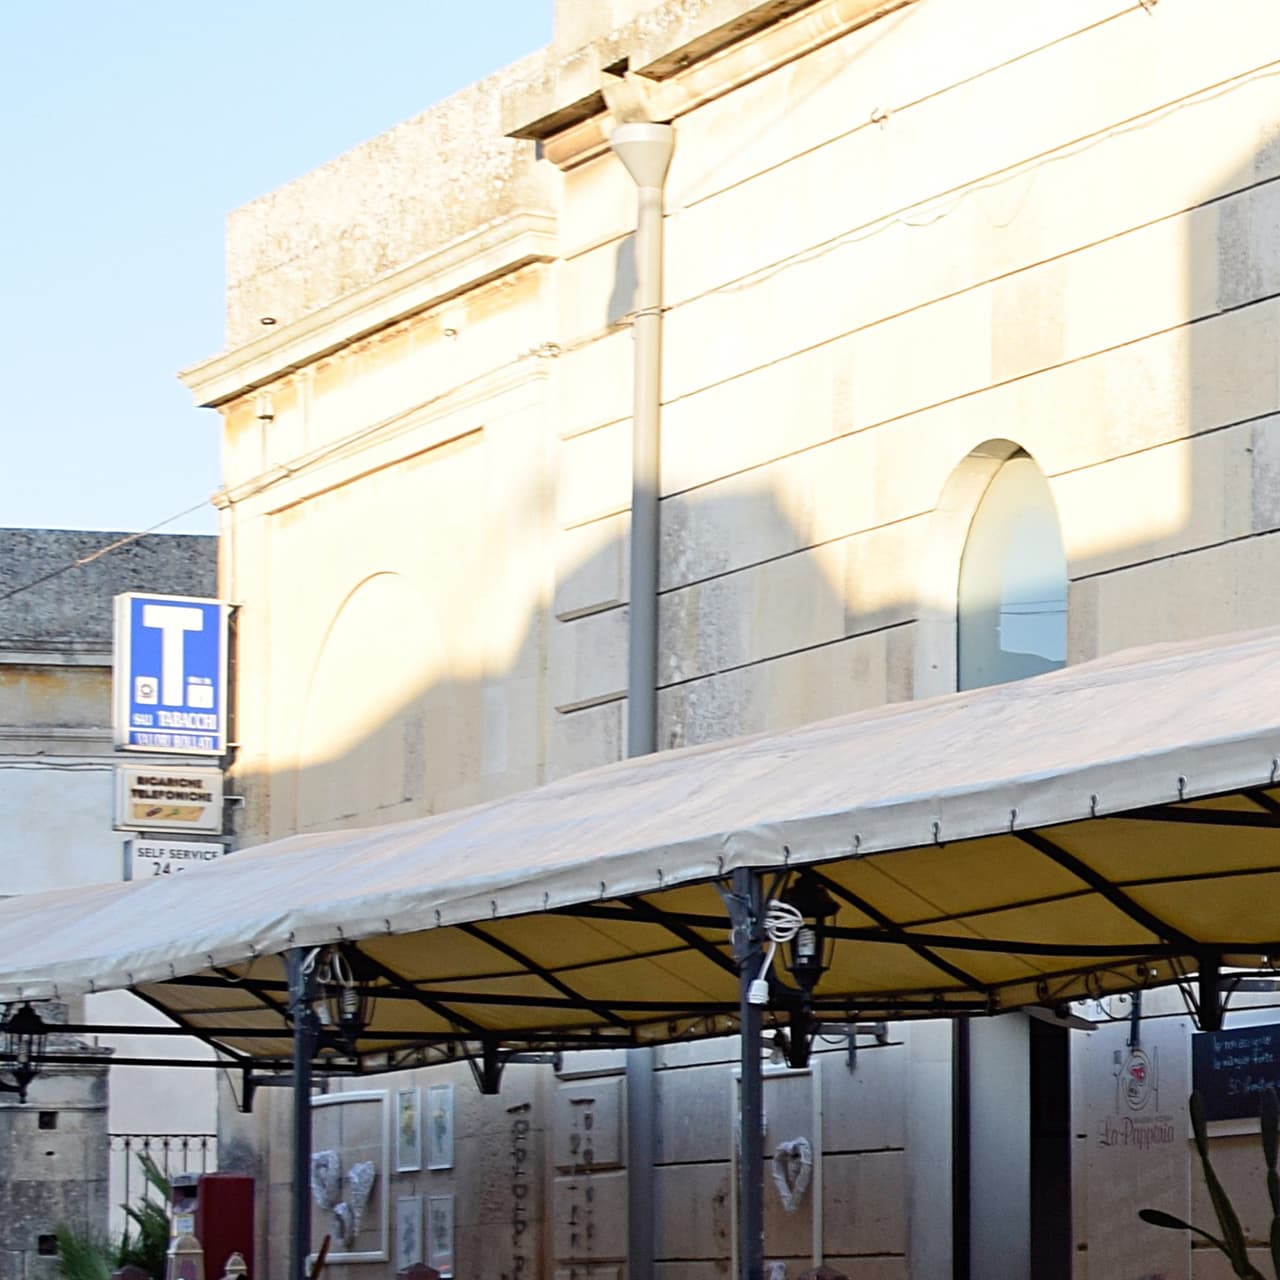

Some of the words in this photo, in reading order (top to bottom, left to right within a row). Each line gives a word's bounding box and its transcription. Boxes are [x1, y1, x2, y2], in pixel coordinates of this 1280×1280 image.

[143, 604, 204, 707] T
[156, 711, 217, 730] TABACCHI
[137, 776, 203, 789] RICARICHE
[131, 789, 213, 802] TELEFONICHE
[138, 847, 166, 858] SELF
[153, 862, 171, 876] 24
